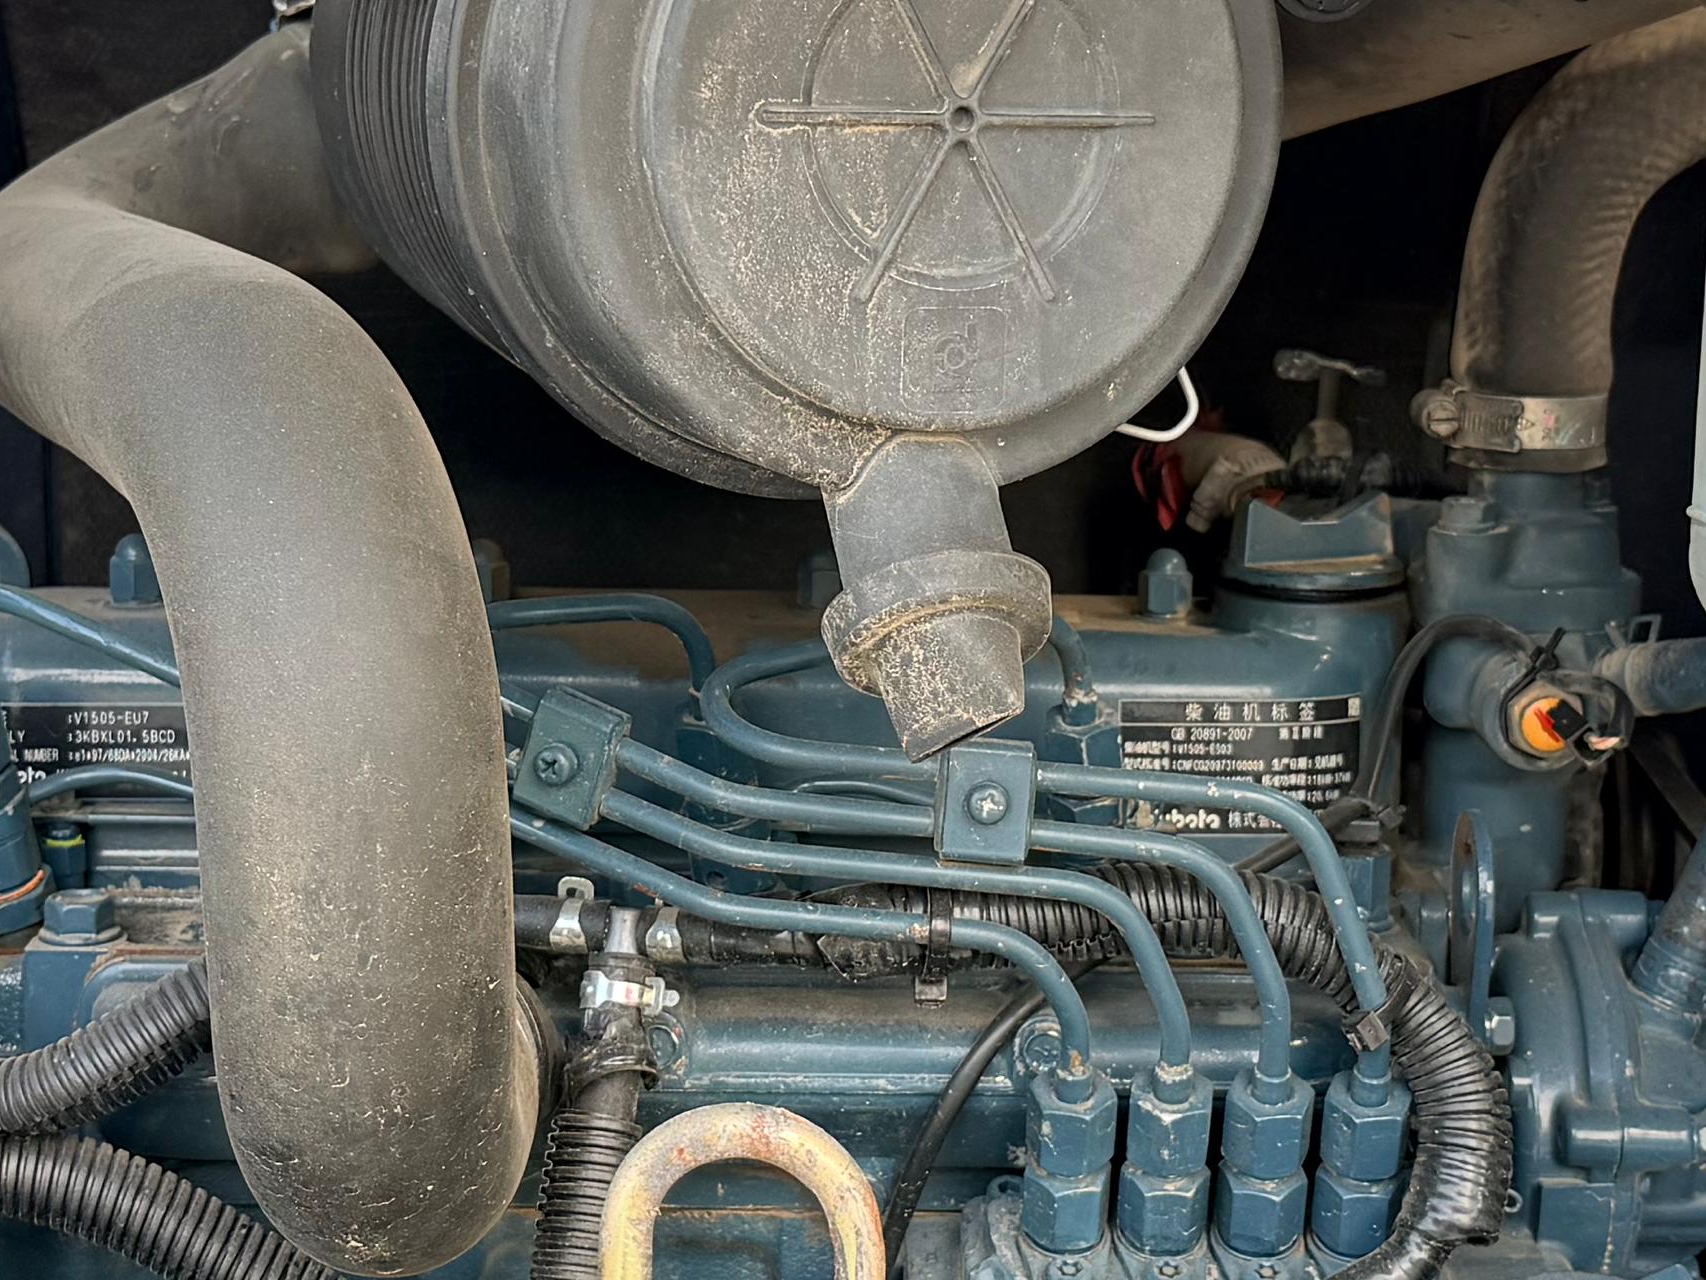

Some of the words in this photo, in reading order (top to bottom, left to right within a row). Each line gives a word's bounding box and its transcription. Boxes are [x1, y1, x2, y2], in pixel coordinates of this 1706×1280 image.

[1185, 702, 1315, 721] 柴油机标签
[1171, 727, 1186, 741] GB
[1190, 726, 1254, 741] 20891-2007
[24, 748, 59, 763] NUMBER
